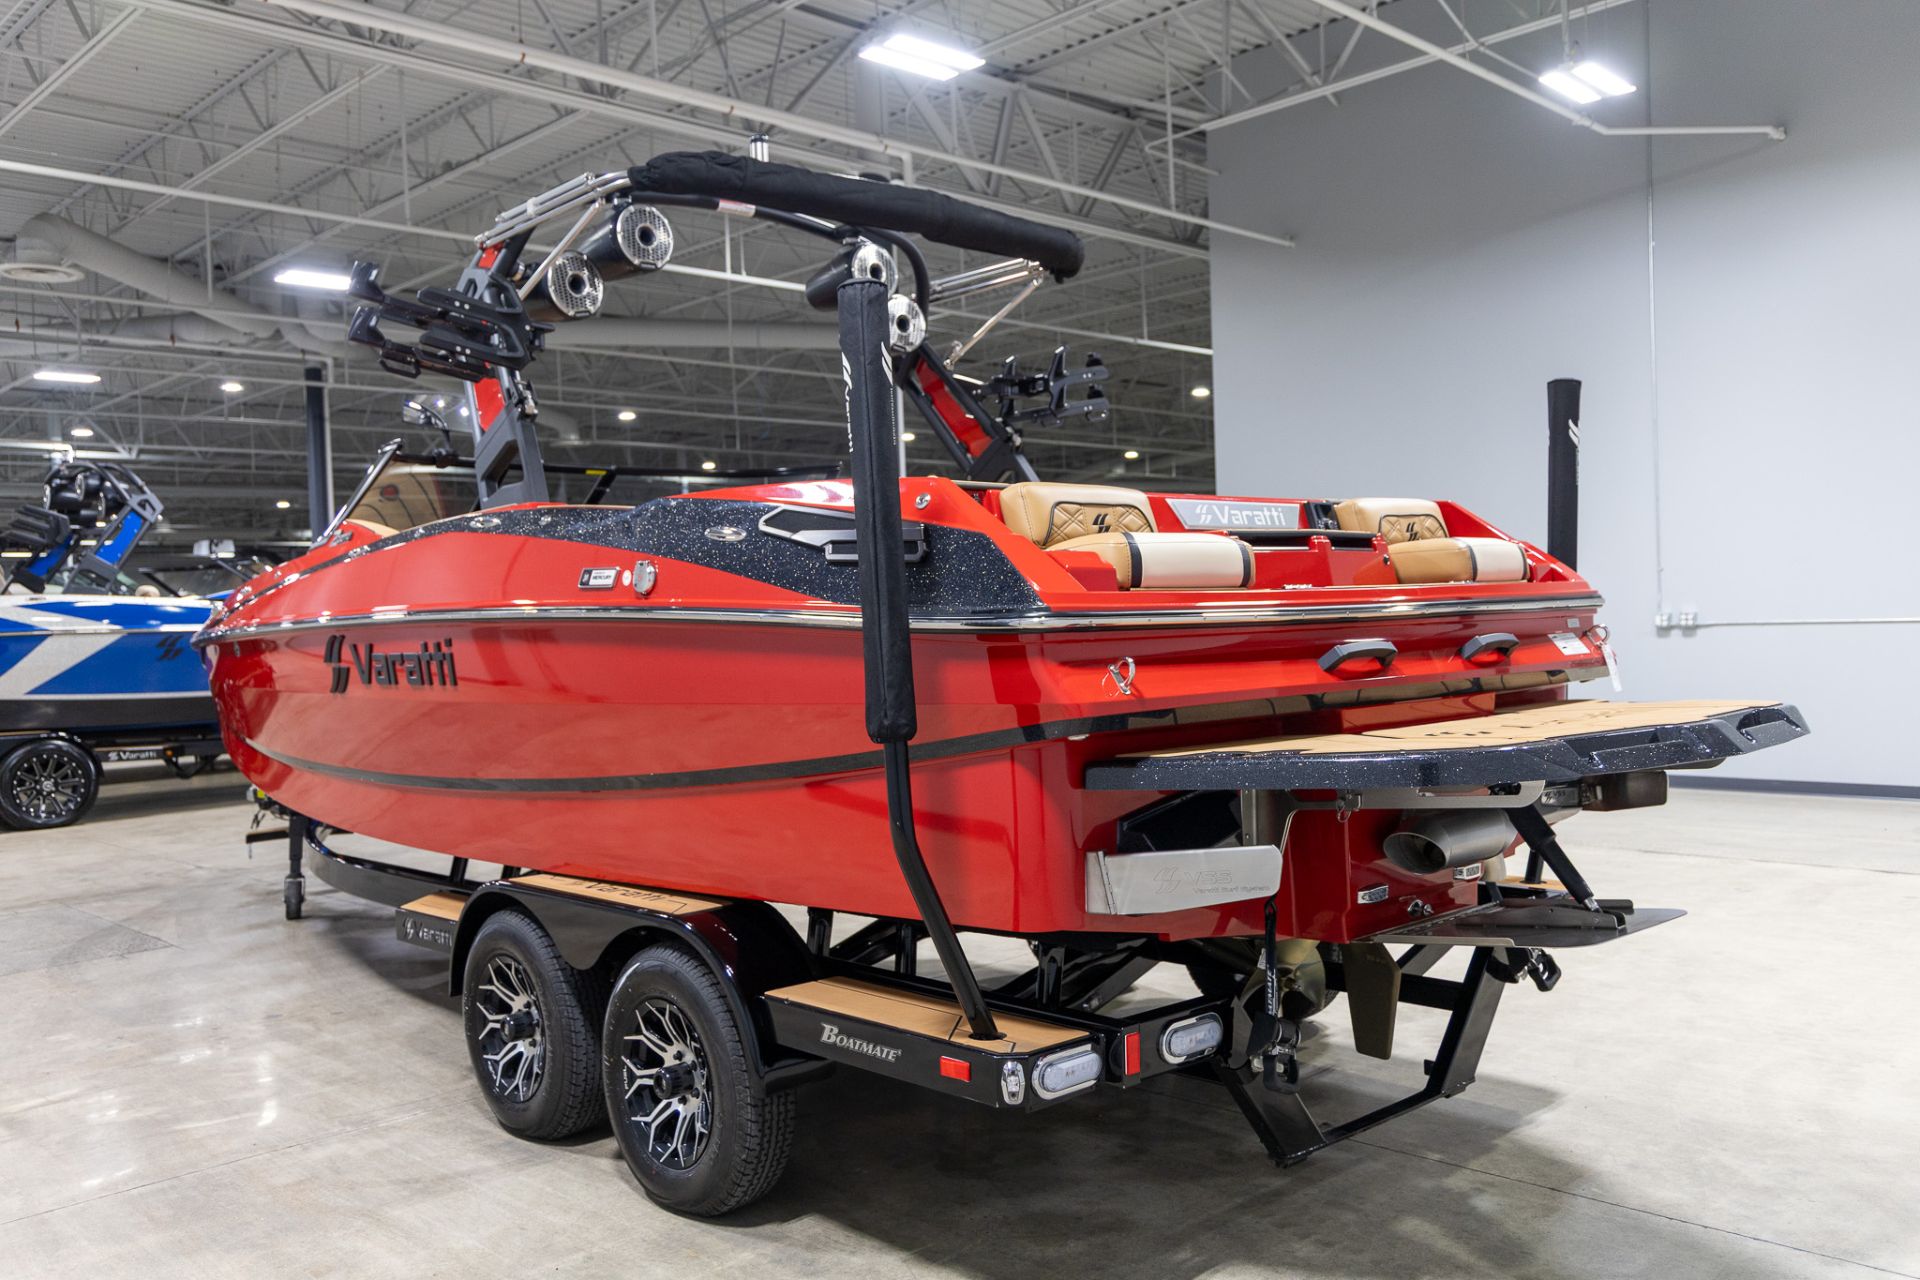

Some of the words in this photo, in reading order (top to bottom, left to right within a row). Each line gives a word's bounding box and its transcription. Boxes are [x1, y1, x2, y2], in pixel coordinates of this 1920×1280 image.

[1211, 504, 1286, 526] Varatti
[349, 638, 458, 687] Varatti
[120, 751, 157, 761] Varatti
[1183, 870, 1233, 886] VSS
[820, 1022, 899, 1063] BOATMATE
